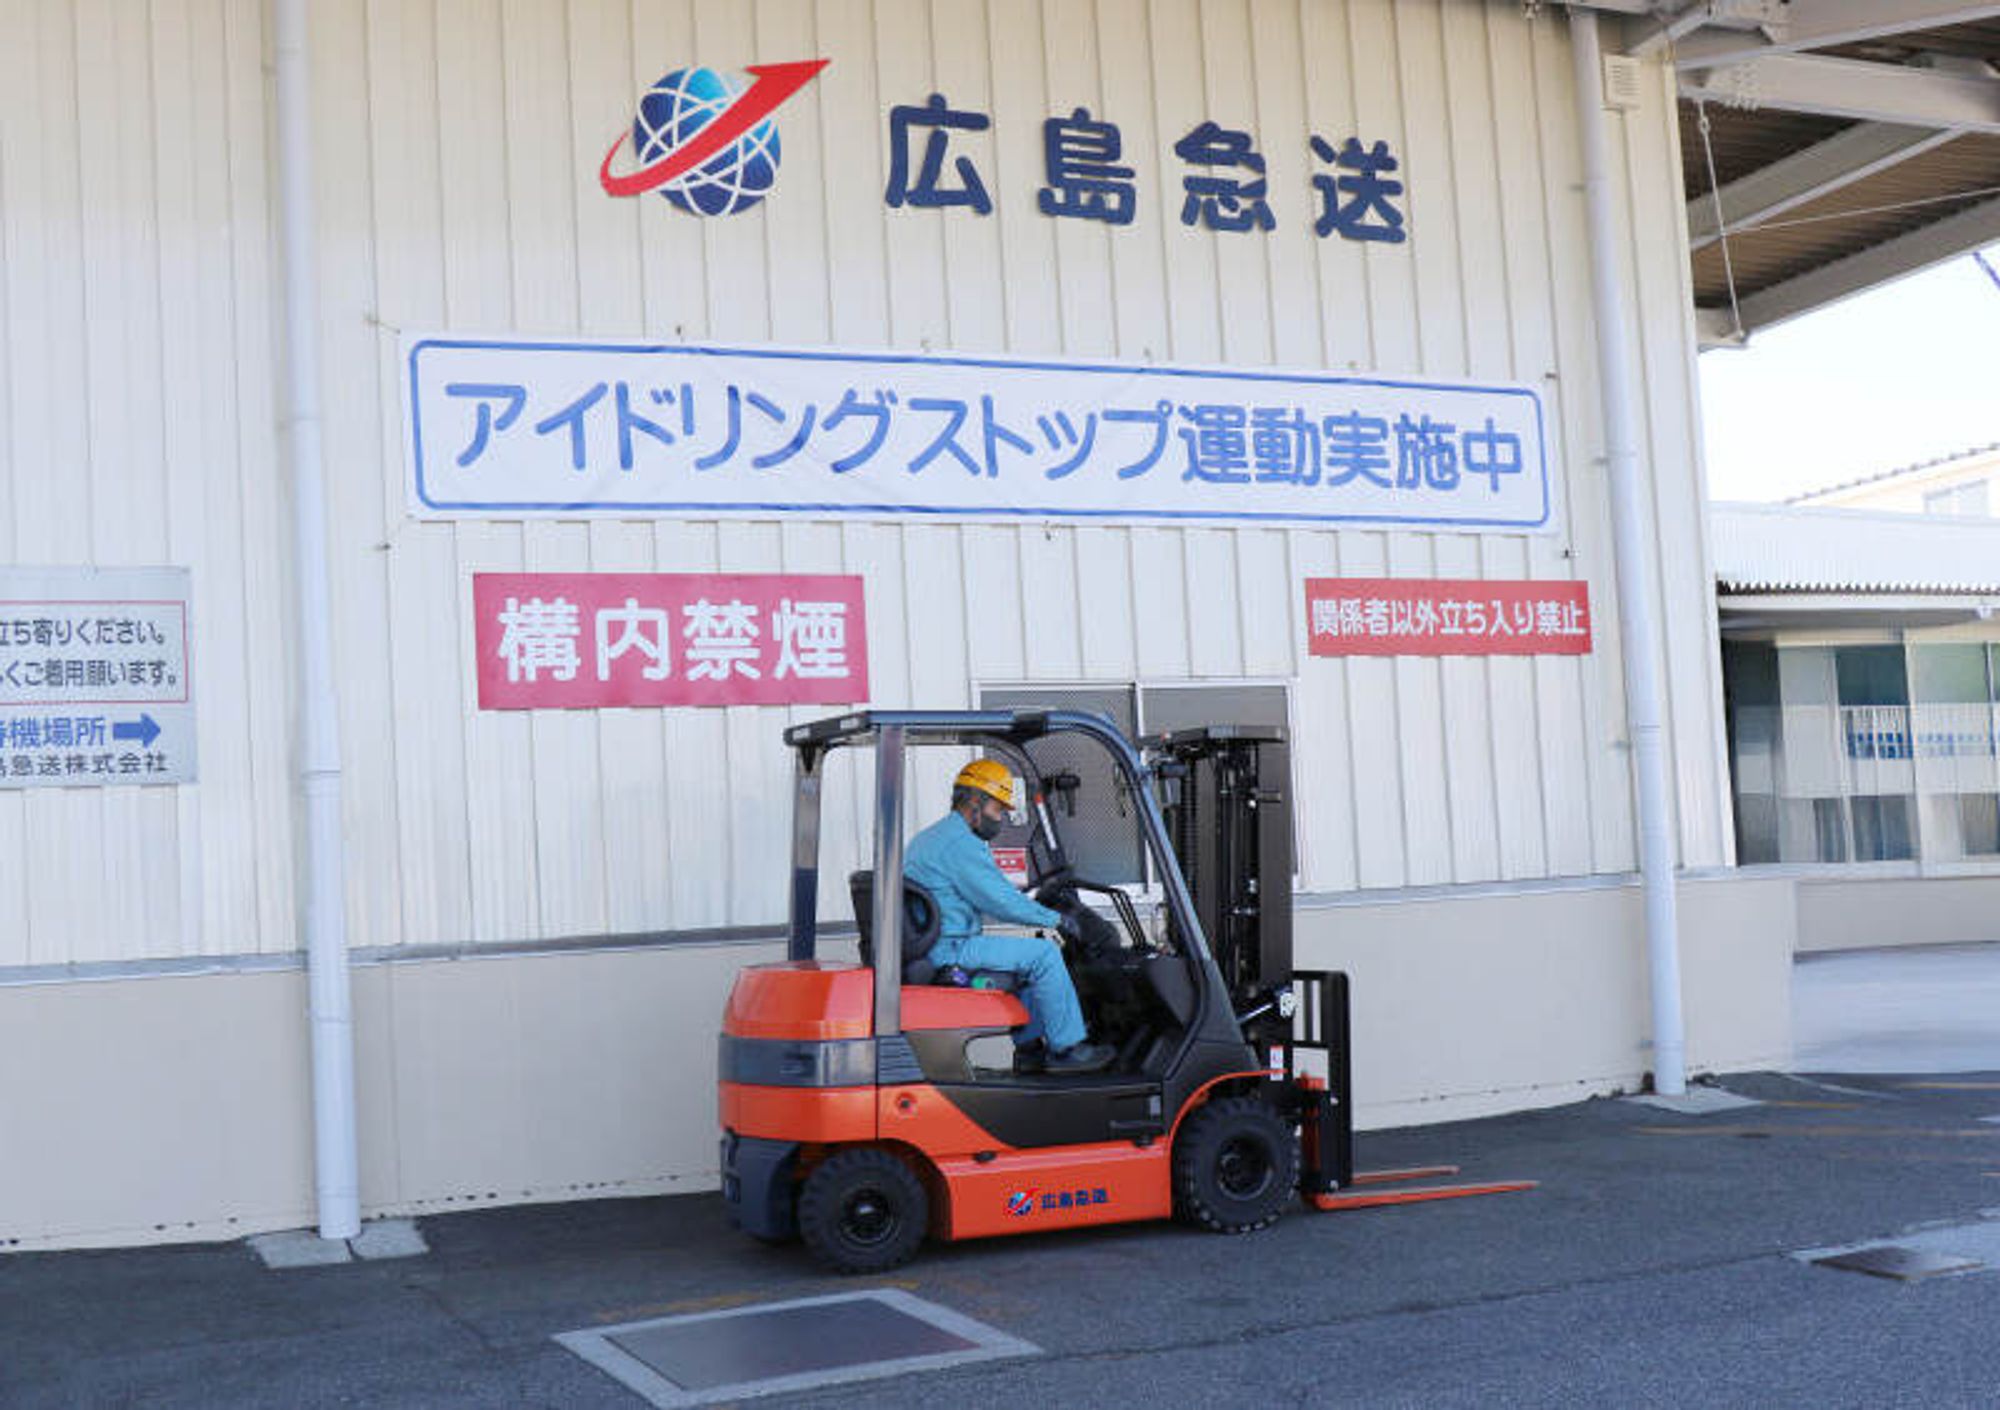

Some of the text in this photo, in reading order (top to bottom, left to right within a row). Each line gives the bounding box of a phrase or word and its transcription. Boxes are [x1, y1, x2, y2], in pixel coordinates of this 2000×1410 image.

[885, 92, 1406, 243] 広島急送
[444, 379, 1524, 493] アイドリングストップ運動実施中
[1312, 597, 1587, 637] 関係者以外立ち入り禁止
[497, 597, 851, 683] 構内禁煙
[0, 659, 176, 687] くご着用願います。
[0, 717, 105, 748] 機場所
[0, 753, 168, 777] 急送株式会社
